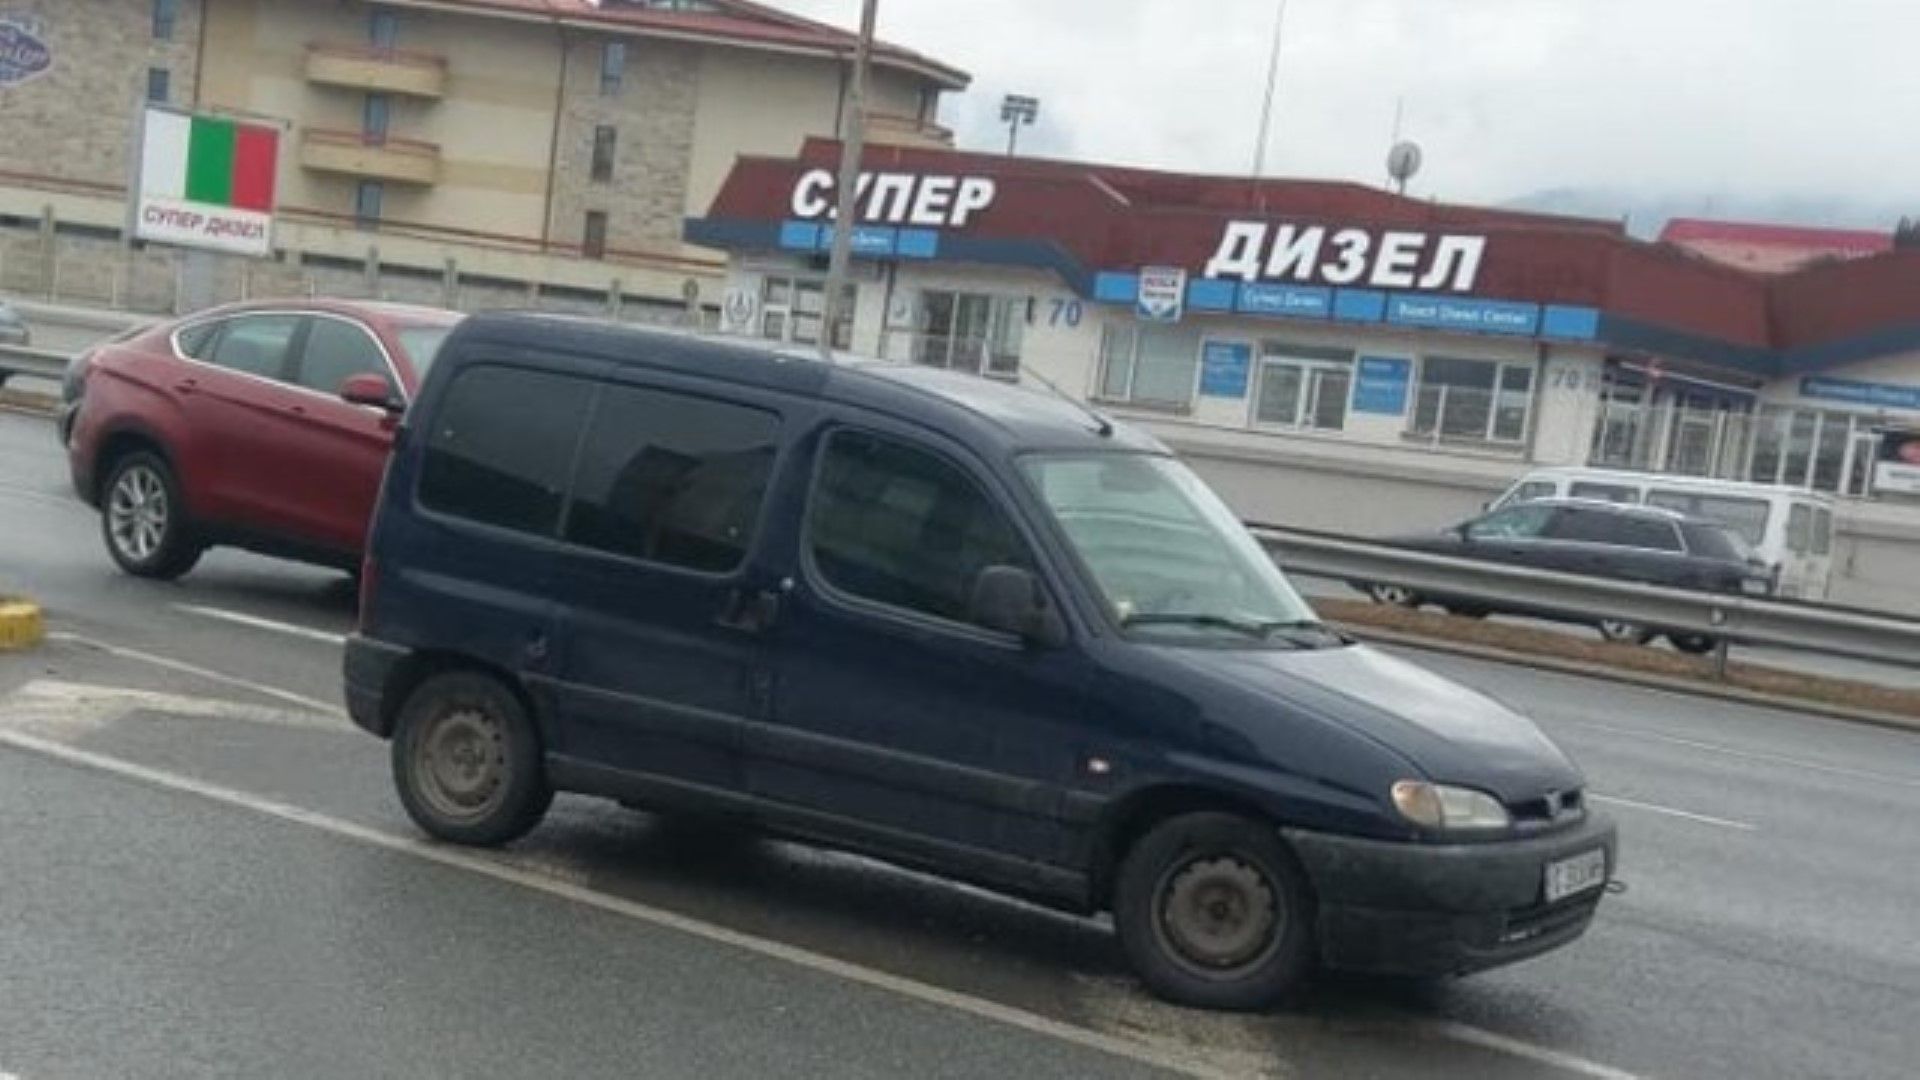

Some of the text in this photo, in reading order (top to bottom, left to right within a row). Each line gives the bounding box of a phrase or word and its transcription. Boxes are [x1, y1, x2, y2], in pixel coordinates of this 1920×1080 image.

[145, 206, 265, 239] СУПЕР ДИЗЕЛ
[1205, 220, 1486, 291] ДИЗЕЛ
[1050, 299, 1083, 327] 70
